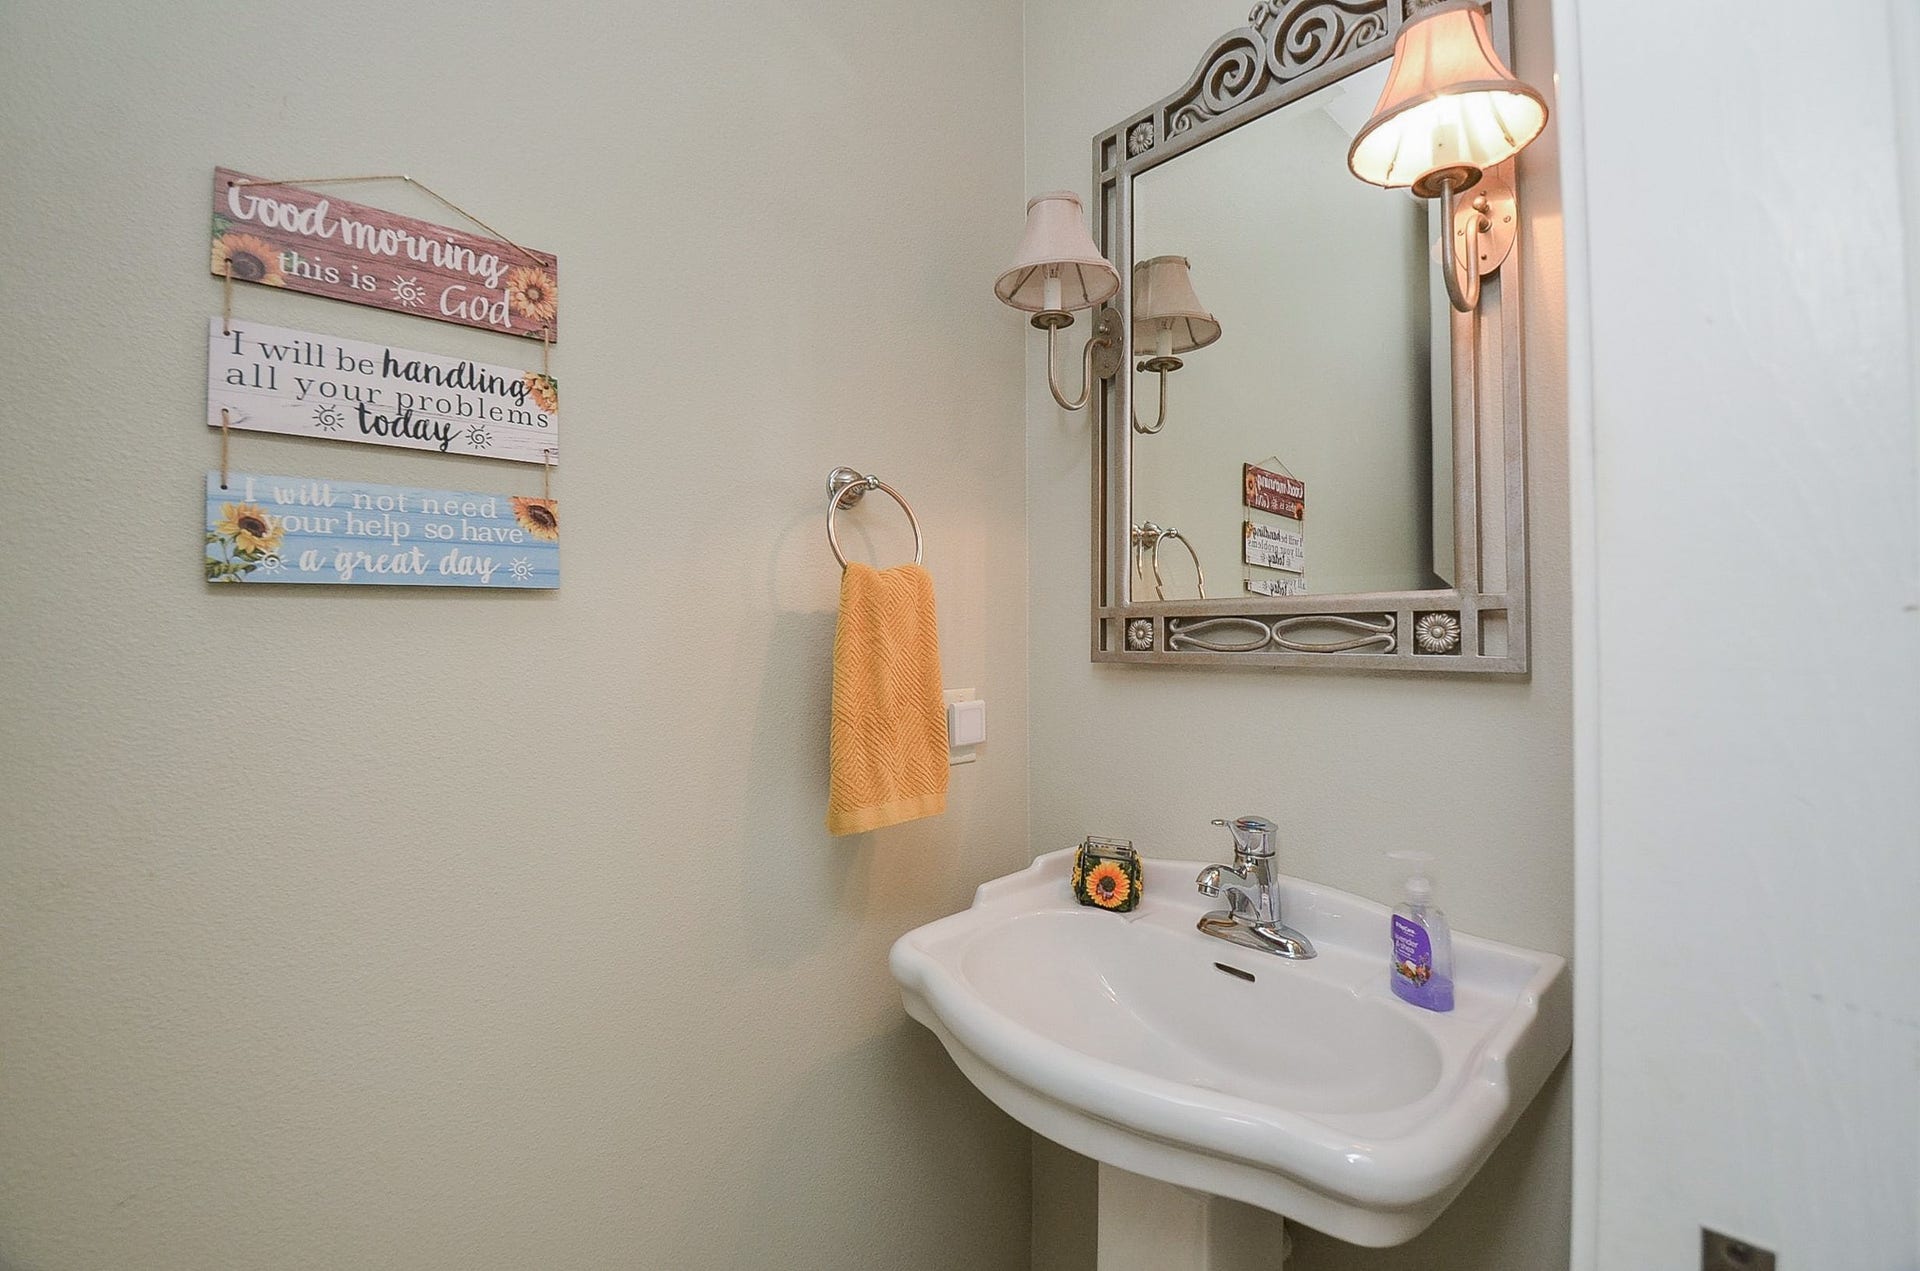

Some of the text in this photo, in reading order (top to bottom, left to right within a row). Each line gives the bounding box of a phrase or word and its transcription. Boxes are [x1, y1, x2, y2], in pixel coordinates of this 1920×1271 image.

[228, 179, 510, 289] Good morning
[278, 251, 512, 329] this is God
[226, 363, 549, 429] all your problems
[231, 330, 532, 406] I will be handling
[355, 402, 463, 452] today
[244, 476, 499, 520] I will not need
[260, 511, 524, 547] your help so have
[299, 547, 502, 584] a great day
